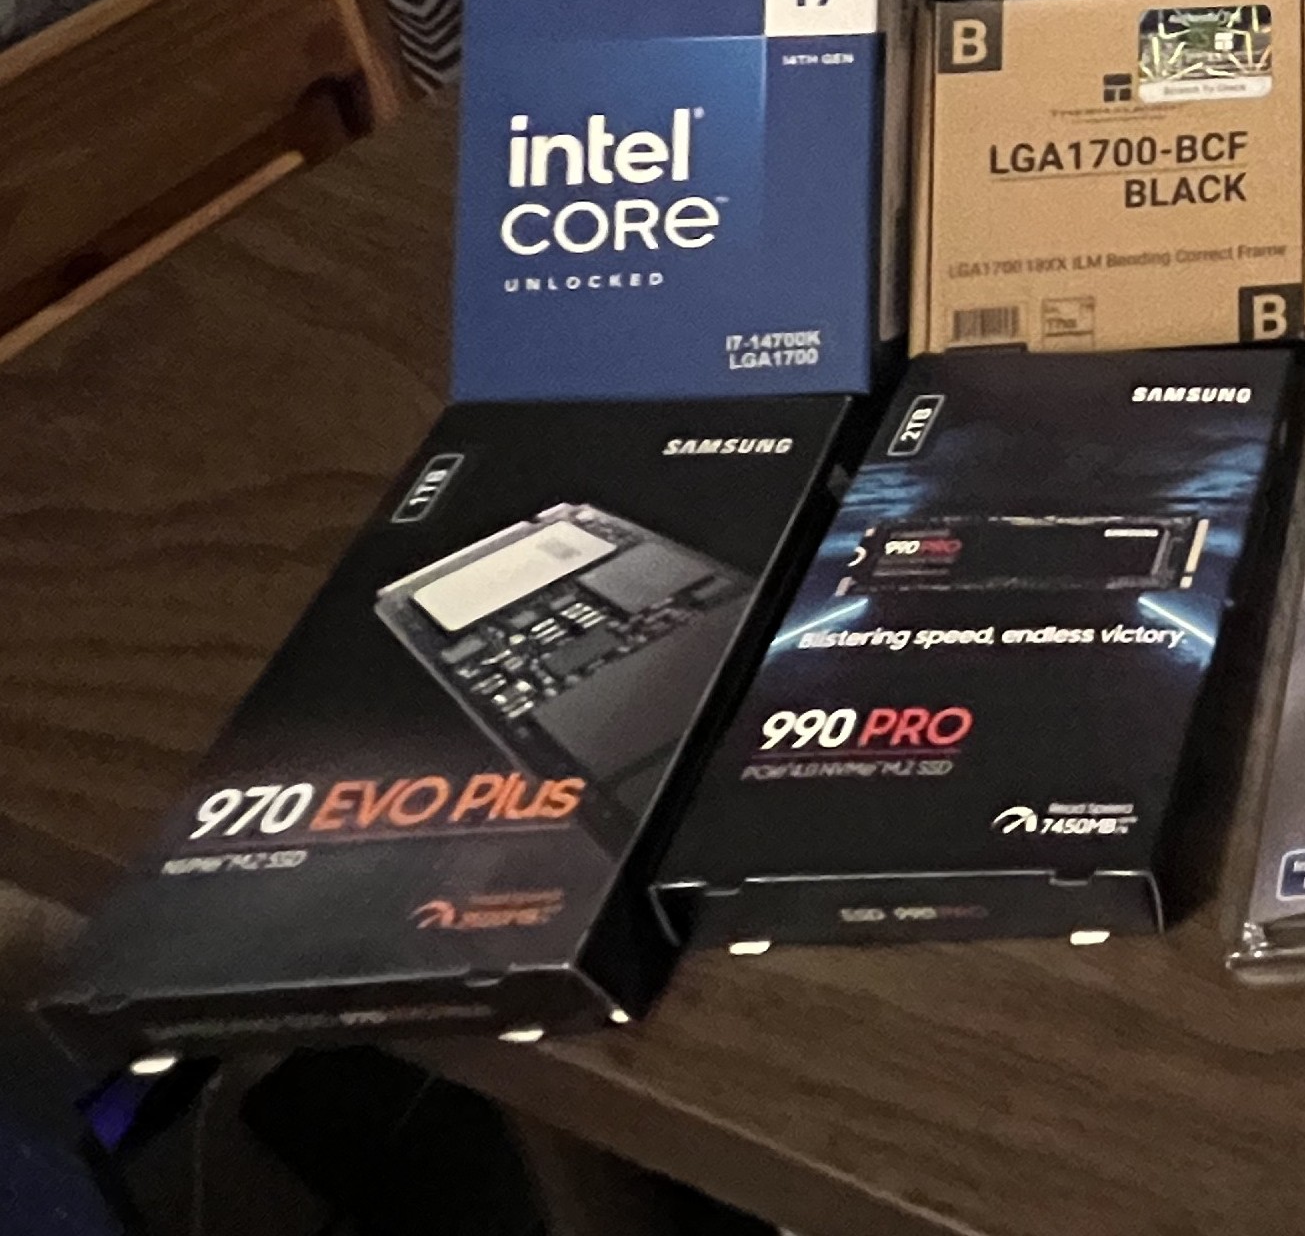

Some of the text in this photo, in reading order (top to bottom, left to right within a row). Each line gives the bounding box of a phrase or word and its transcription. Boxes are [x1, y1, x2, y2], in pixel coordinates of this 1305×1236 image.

[952, 18, 987, 65] B
[508, 108, 691, 188] intel
[989, 131, 1248, 174] LGA1700-BCF
[1124, 172, 1247, 209] BLACK
[1237, 243, 1287, 260] Frame
[504, 273, 664, 292] UNLOCKED
[1253, 294, 1287, 339] B
[729, 348, 819, 370] LGA1700
[1131, 386, 1251, 403] SAMSUNG
[663, 437, 795, 456] SAMSUNG
[408, 468, 448, 506] 1TB
[1001, 624, 1095, 646] endless
[760, 706, 973, 750] 990 PRO
[189, 781, 316, 841] 970
[308, 775, 455, 832] EVO
